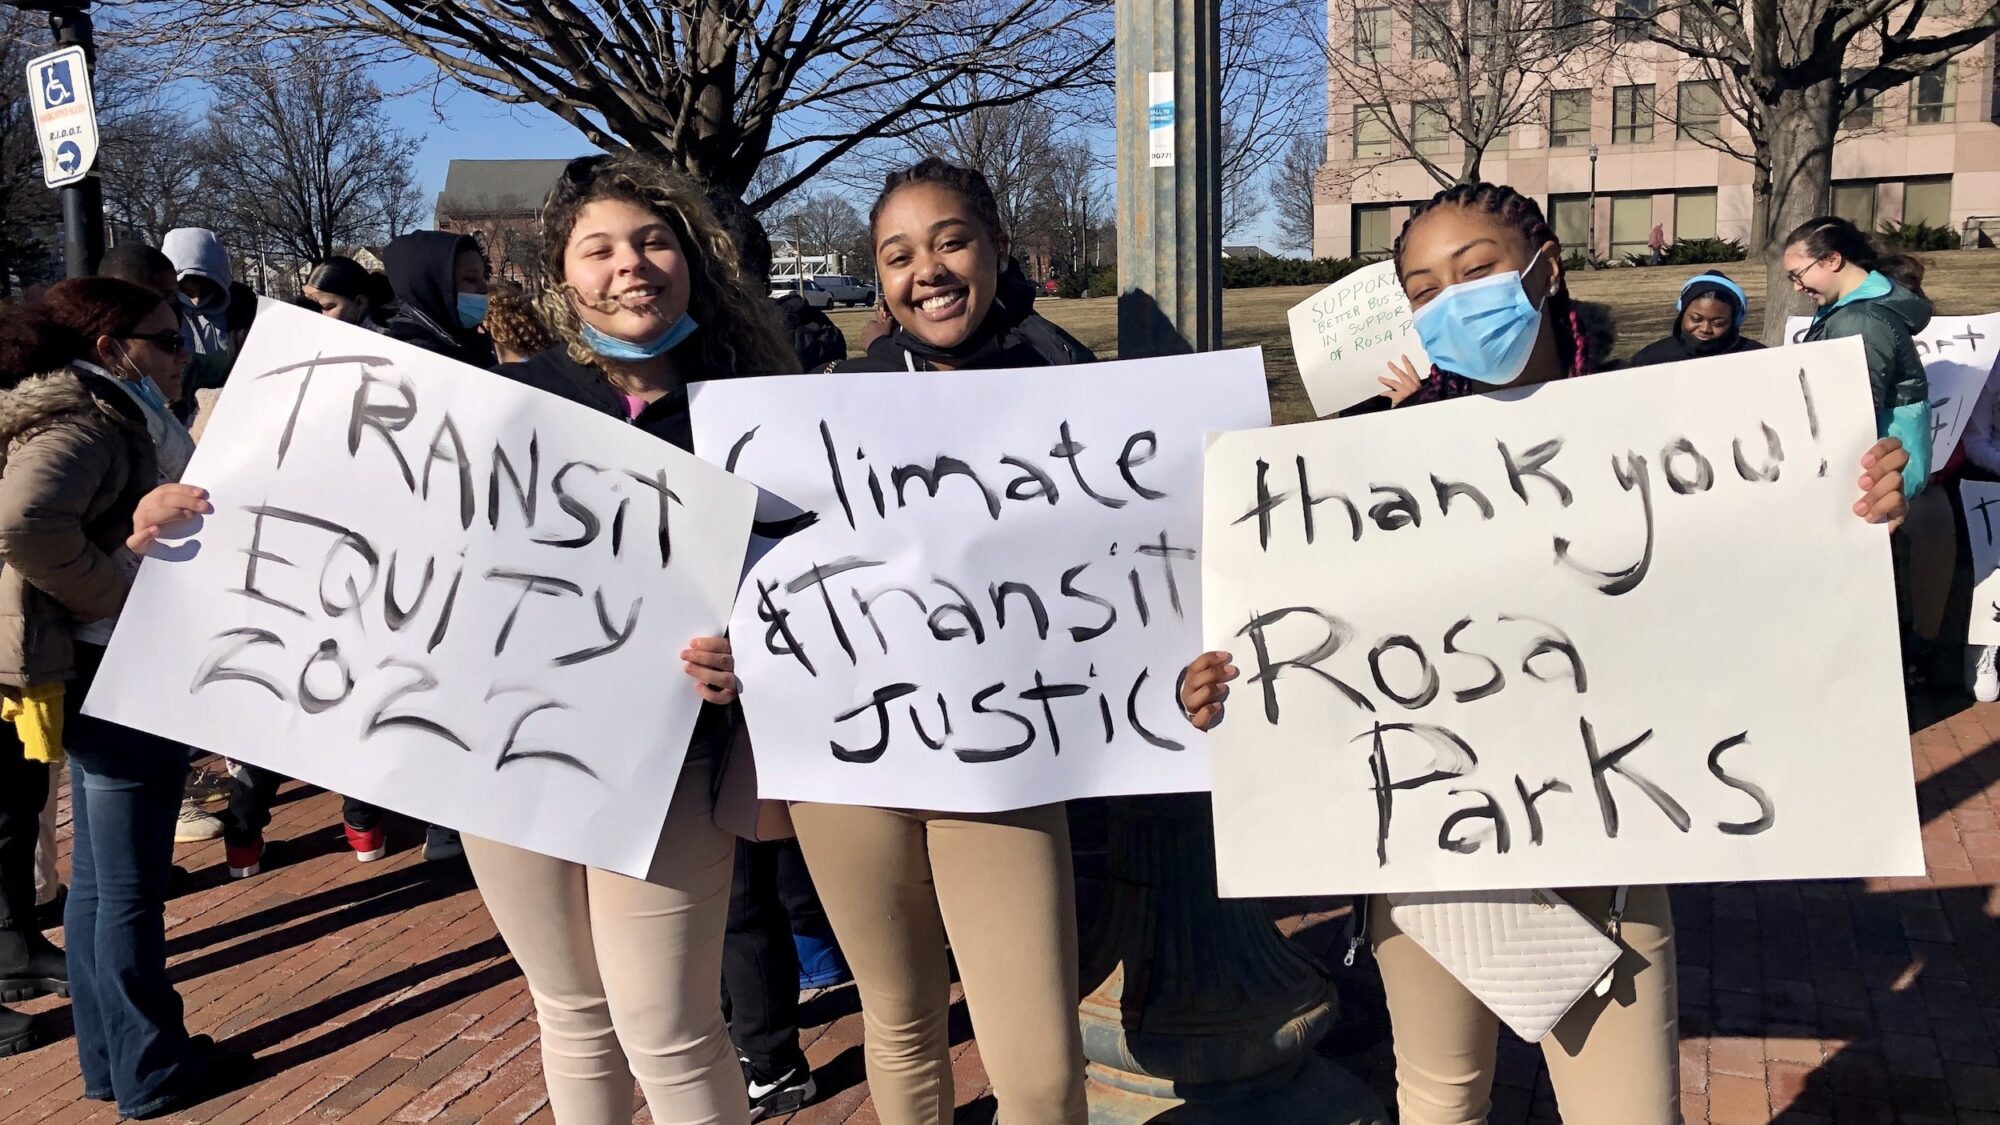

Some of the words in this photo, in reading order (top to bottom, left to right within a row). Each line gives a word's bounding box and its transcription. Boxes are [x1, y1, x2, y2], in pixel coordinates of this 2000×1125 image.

[49, 126, 82, 141] R.I.D.O.T.
[1312, 271, 1397, 323] SUPPORT
[1317, 305, 1361, 334] BETTER
[1367, 294, 1390, 311] BUS
[1322, 332, 1338, 348] IN
[1348, 304, 1412, 336] SUPPOR
[1329, 346, 1344, 362] OF
[1353, 329, 1393, 352] ROSA
[1552, 367, 1829, 596] you!
[1234, 605, 1588, 725] Rosa
[190, 625, 602, 779] 2022
